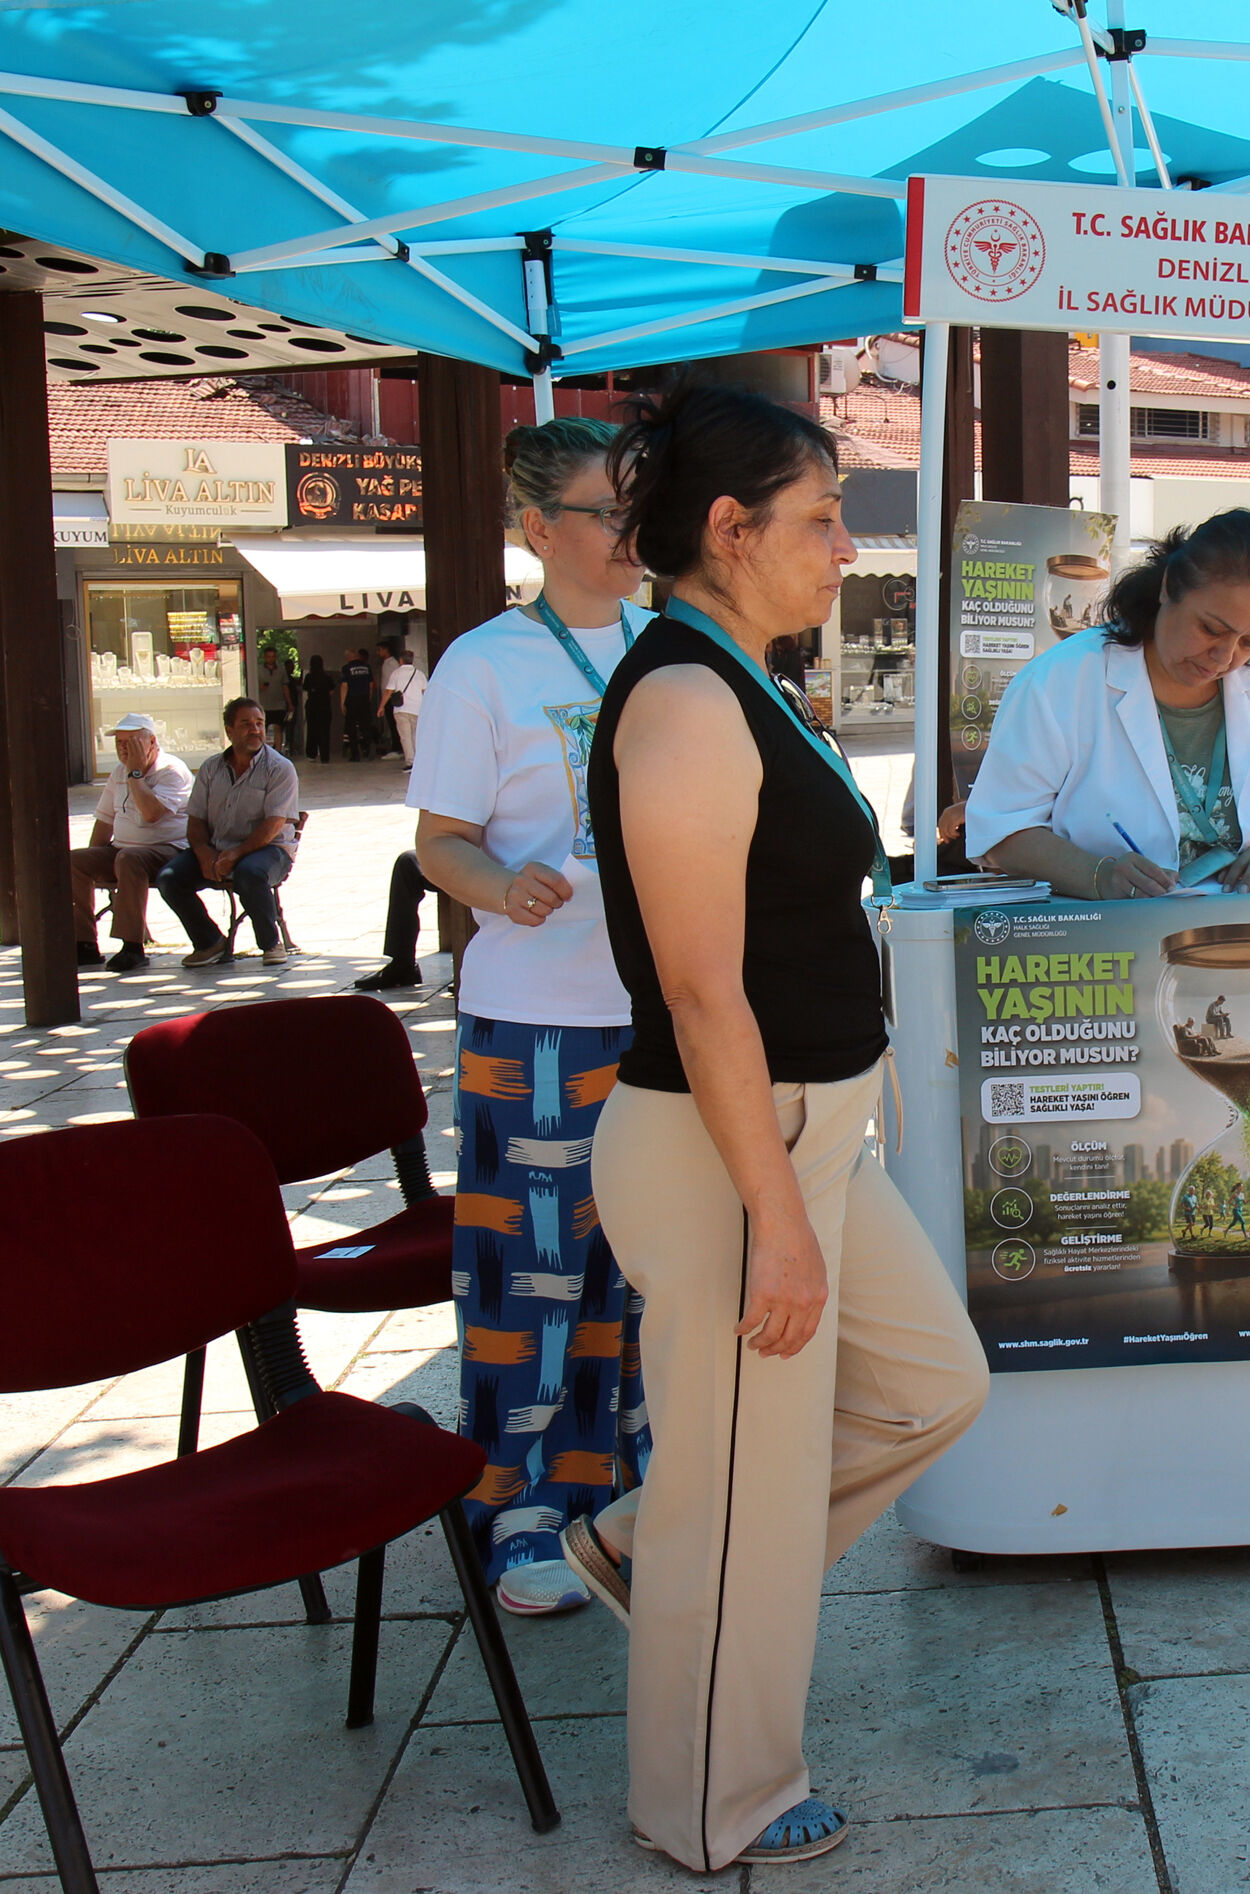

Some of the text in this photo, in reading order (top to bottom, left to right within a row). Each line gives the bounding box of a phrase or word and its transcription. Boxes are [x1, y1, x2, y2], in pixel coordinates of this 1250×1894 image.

[1072, 212, 1111, 236] T.C.
[1120, 211, 1207, 242] SAĞLIK
[1058, 285, 1079, 311] İL
[1086, 289, 1178, 316] SAĞLIK
[125, 472, 276, 504] LİVA ALTIN
[355, 474, 395, 496] YAĞ
[164, 549, 224, 564] ALTIN
[961, 560, 1035, 580] HAREKET
[961, 579, 1034, 601] YAŞININ
[339, 590, 415, 610] LIVA
[961, 600, 1034, 614] KAÇ OLDUĞUNU
[961, 613, 1035, 627] BİLİYOR MUSUN?
[1027, 914, 1056, 923] SAĞLIK
[1058, 912, 1102, 922] BAKANLIĞI
[976, 952, 1135, 984] HAREKET
[976, 984, 1134, 1024] YAŞININ
[981, 1019, 1136, 1046] KAÇ OLDUĞUNU
[980, 1045, 1140, 1068] BİLİYOR MUSUN?
[1029, 1083, 1069, 1093] TESTLERİ
[1030, 1091, 1130, 1104] HAREKET YAŞINI ÖĞREN
[1030, 1102, 1095, 1113] SAĞLIKLI YAŞA!
[1071, 1140, 1107, 1152] ÖLÇÜM
[1050, 1190, 1131, 1202] DEĞERLENDİRME
[1060, 1233, 1123, 1245] GELİŞTİRME
[998, 1336, 1089, 1349] www.shm.saglik.gov.tr
[1123, 1331, 1208, 1344] #HareketYaşınıÖğren
